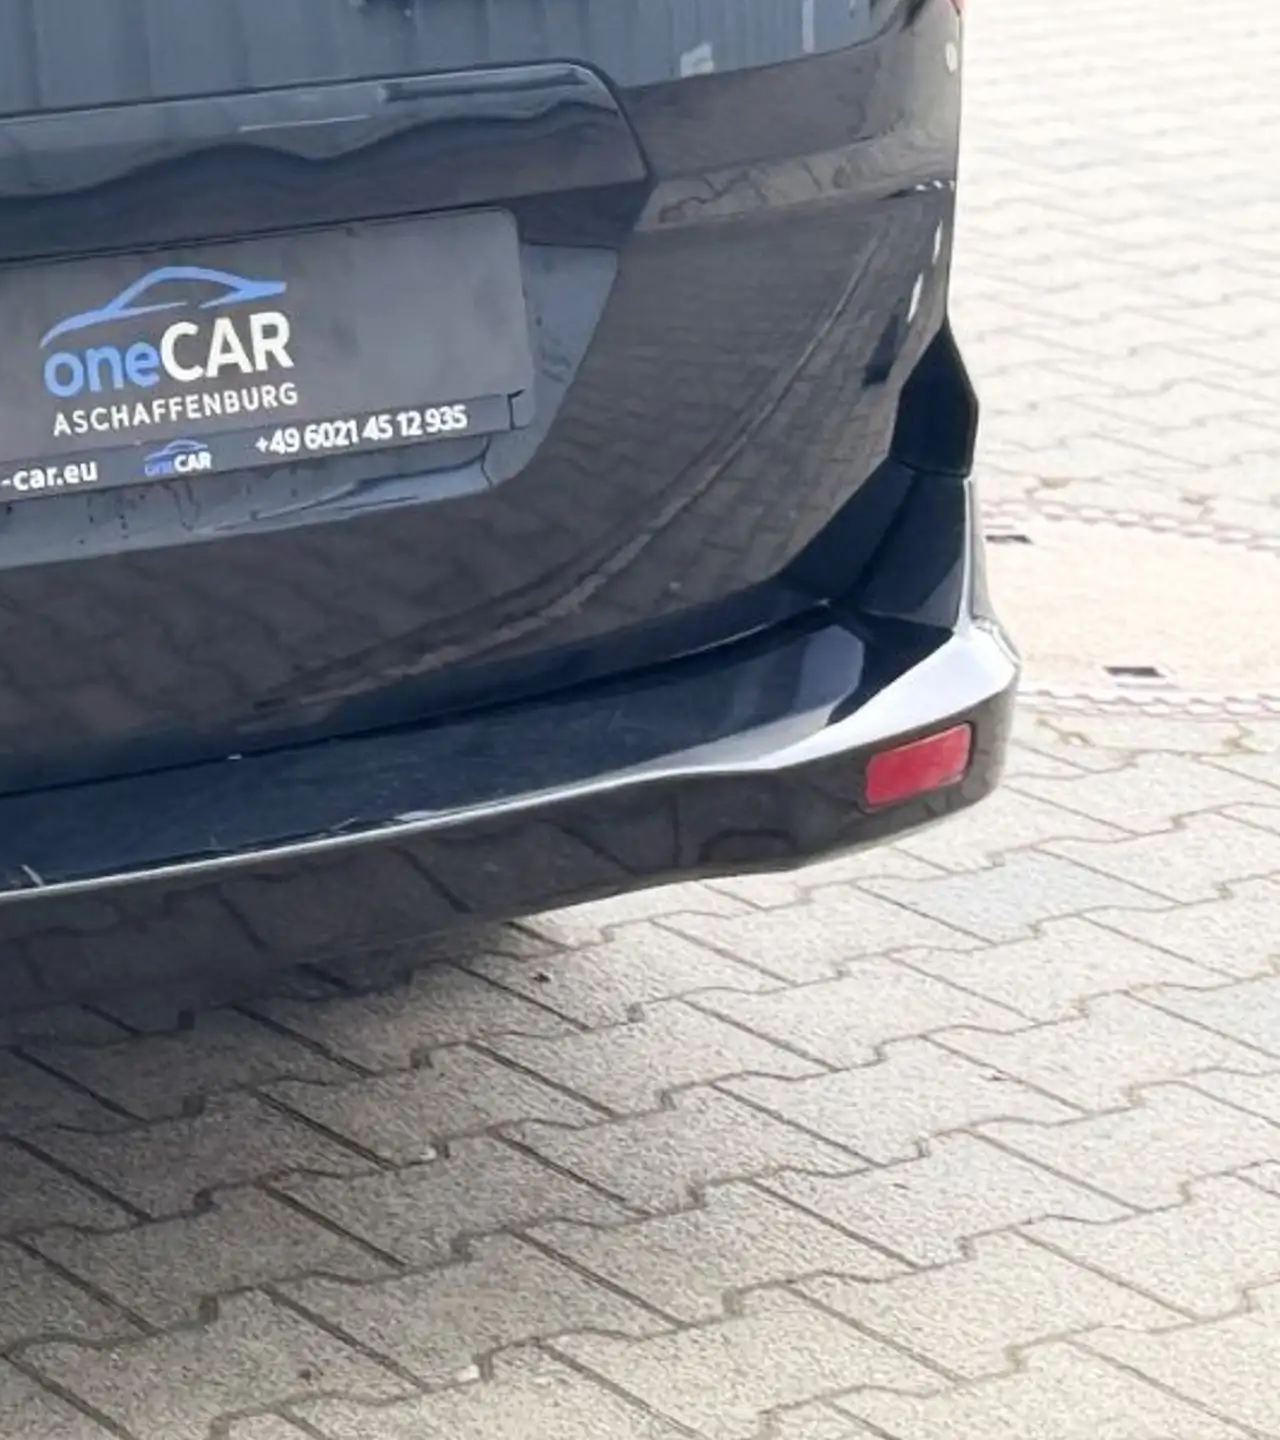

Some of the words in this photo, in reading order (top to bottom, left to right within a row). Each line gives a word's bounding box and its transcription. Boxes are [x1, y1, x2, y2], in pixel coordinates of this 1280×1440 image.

[44, 312, 294, 397] oneCAR
[53, 382, 298, 437] ASCHAFFENBURG
[256, 427, 300, 454] +49
[304, 419, 359, 449] 6021
[363, 414, 393, 441] 45
